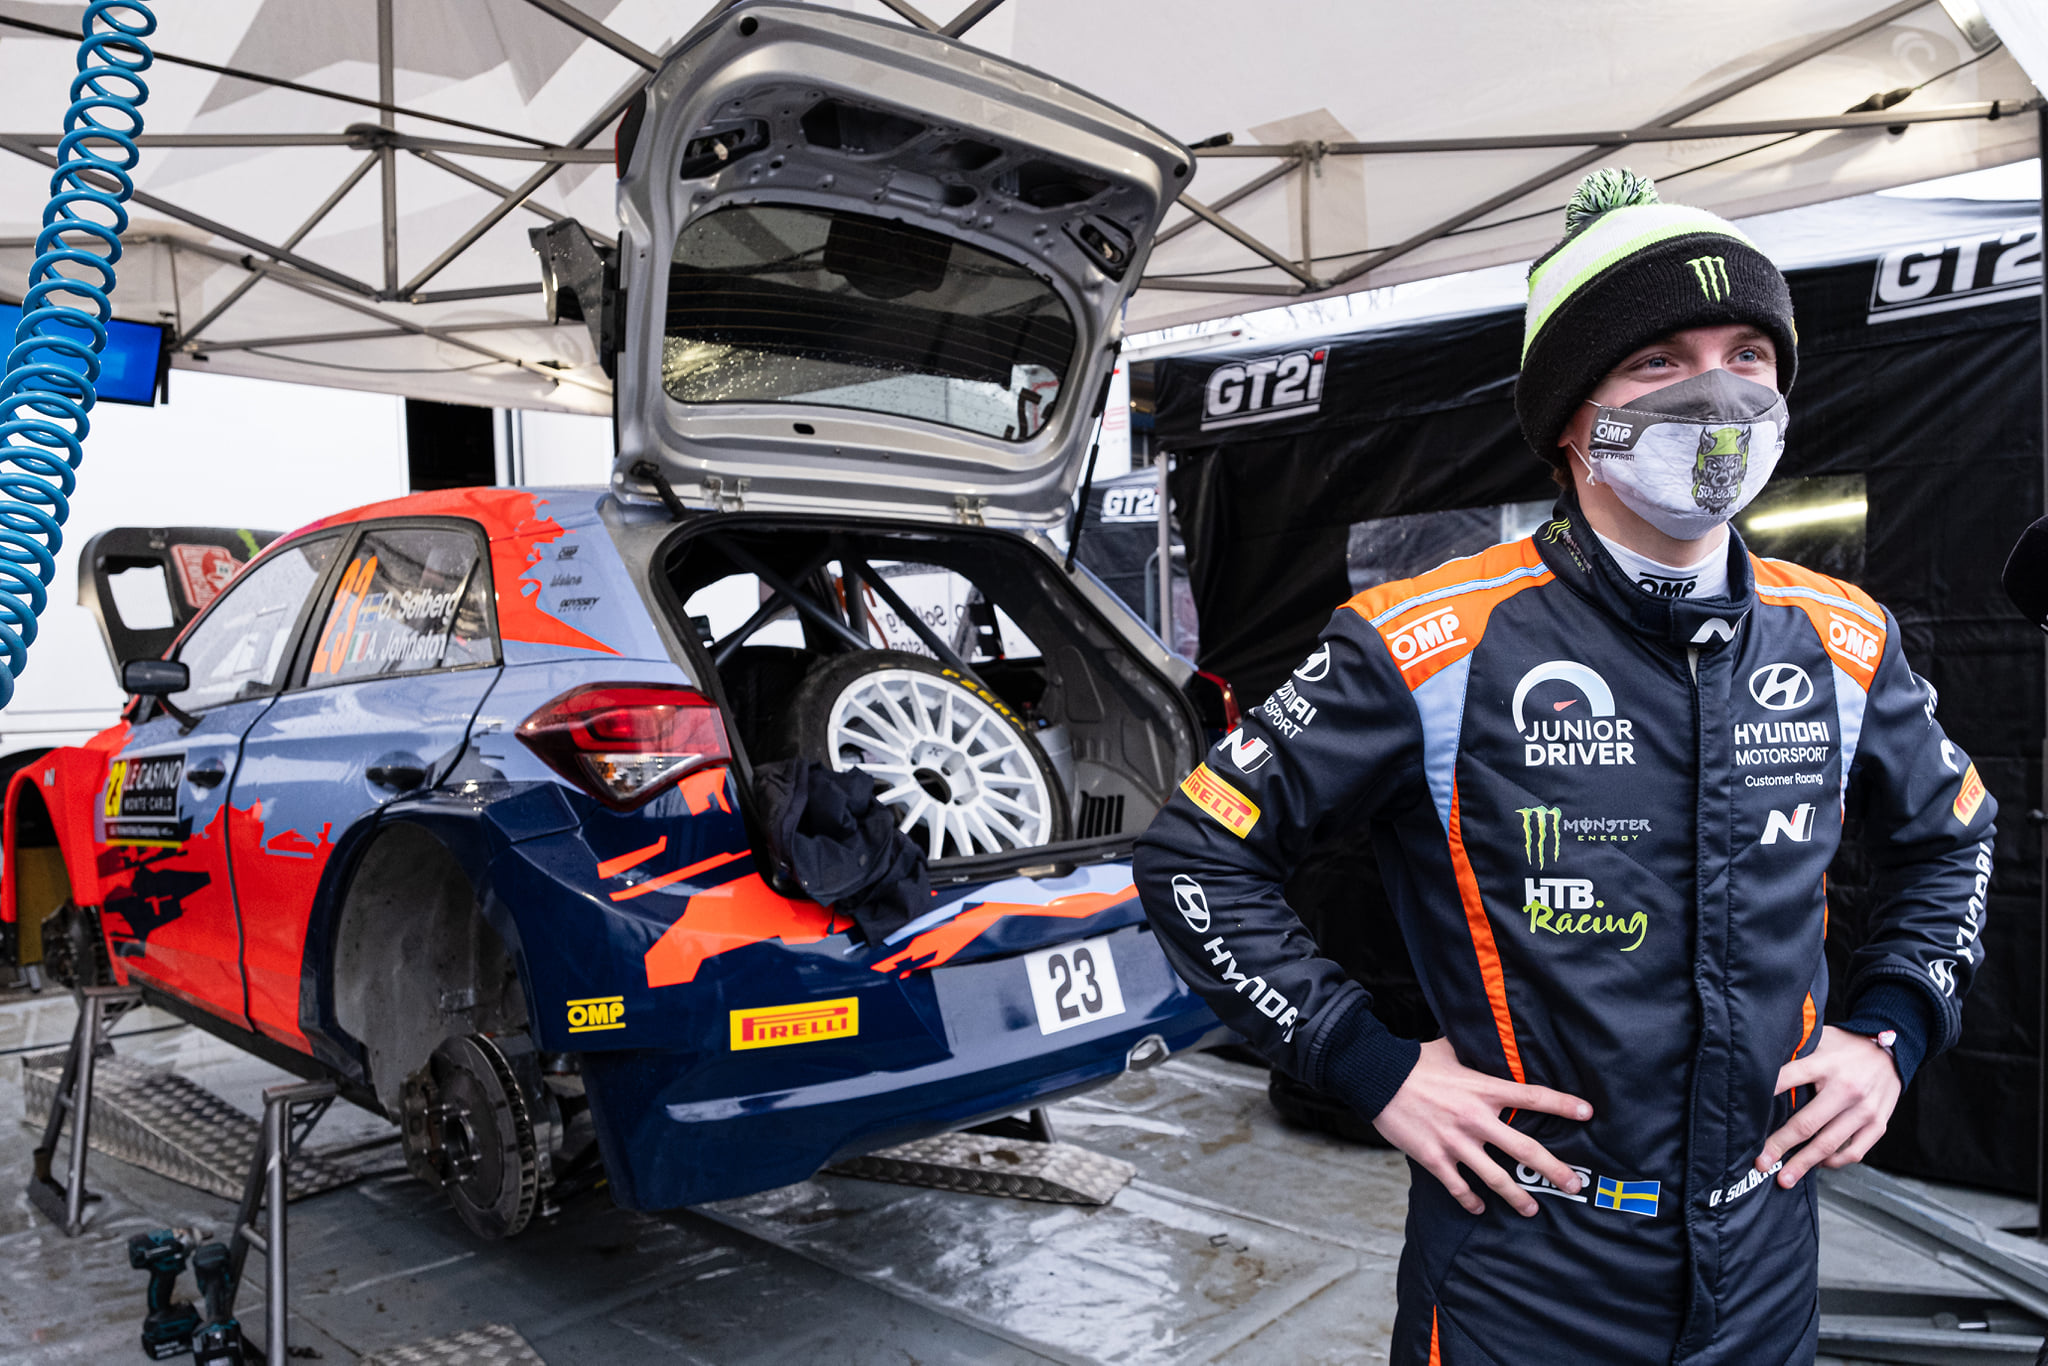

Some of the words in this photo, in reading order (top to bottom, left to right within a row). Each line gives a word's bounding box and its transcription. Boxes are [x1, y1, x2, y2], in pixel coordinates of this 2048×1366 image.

[1207, 350, 1326, 417] GT2i
[1594, 424, 1633, 444] OMP
[311, 556, 378, 674] 23
[1391, 613, 1461, 661] OMP
[1828, 620, 1879, 663] OMP
[1524, 719, 1635, 742] JUNIOR
[1734, 722, 1831, 745] HYUNDAI
[1525, 743, 1636, 767] DRIVER
[1735, 747, 1829, 766] MOTORSPORT
[136, 760, 182, 790] CASINO
[1744, 776, 1793, 788] Customer
[1795, 773, 1824, 788] Racing
[124, 796, 173, 811] MONTE-CARLO
[1185, 767, 1252, 828] PIRELLI
[1577, 834, 1639, 842] ENERGY
[1523, 900, 1648, 951] Racing
[1047, 947, 1104, 1021] 23
[567, 1002, 625, 1028] OMP
[742, 1007, 848, 1042] PIRELLI
